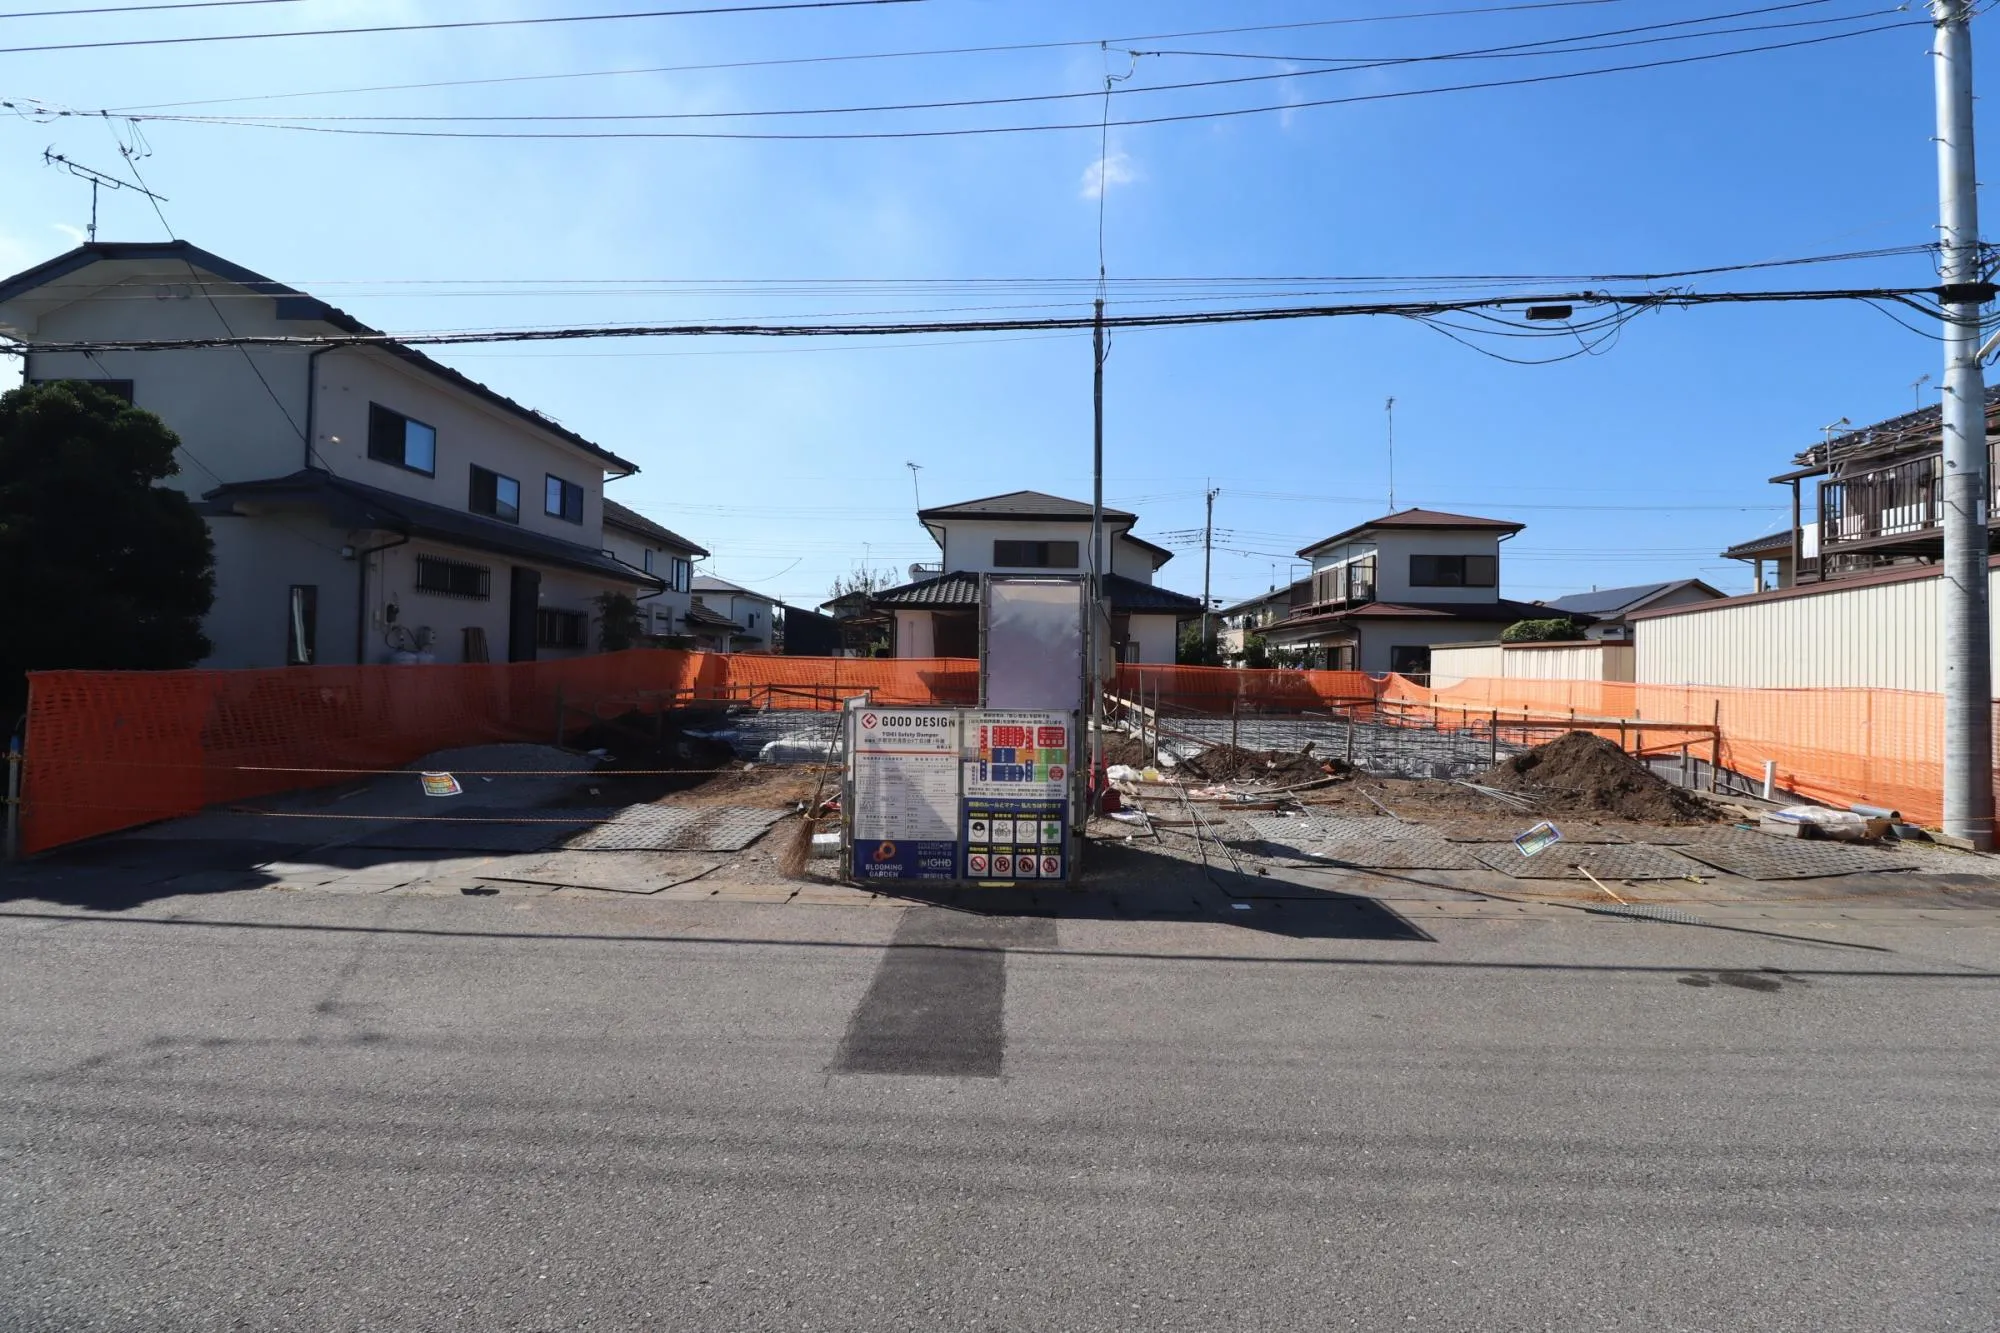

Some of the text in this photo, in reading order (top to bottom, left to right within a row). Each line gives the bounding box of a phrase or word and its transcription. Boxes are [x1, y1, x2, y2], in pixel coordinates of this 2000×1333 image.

[882, 716, 912, 727] GOOD
[915, 716, 956, 728] DESIGN
[865, 863, 903, 871] BLOOMING
